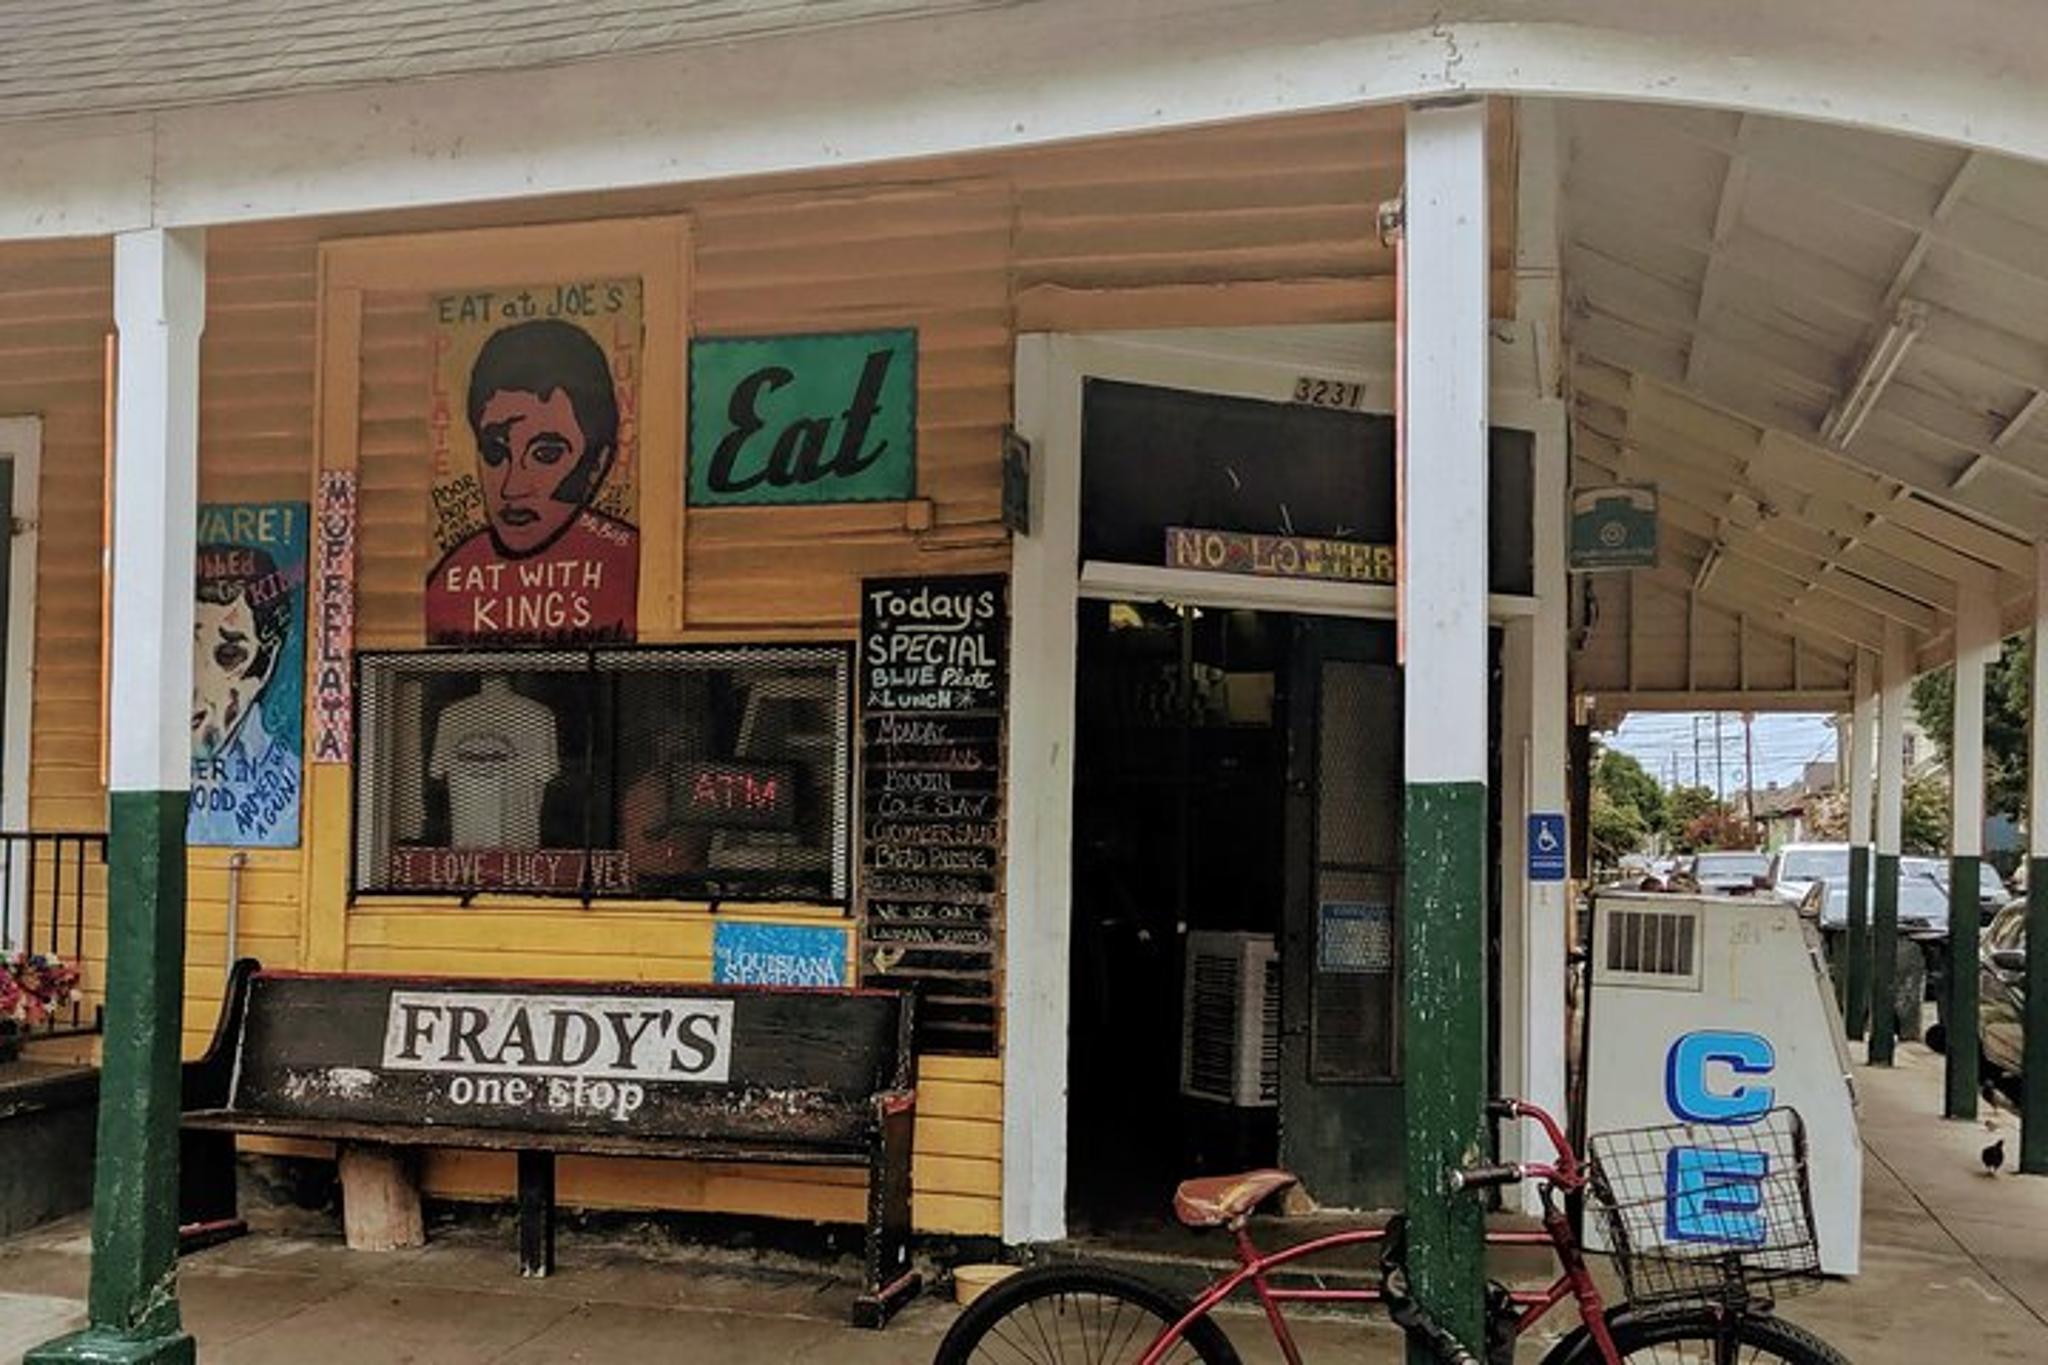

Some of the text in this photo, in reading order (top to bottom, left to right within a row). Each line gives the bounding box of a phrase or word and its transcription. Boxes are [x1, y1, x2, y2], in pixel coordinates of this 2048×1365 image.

[438, 284, 624, 323] EAT at JOE'S
[1294, 377, 1362, 408] 3231
[706, 349, 895, 493] Eat
[1176, 531, 1226, 569] NO
[446, 560, 603, 593] EAT WITH
[473, 591, 592, 631] KING'S
[867, 633, 997, 667] SPECIAL
[871, 665, 937, 689] BLUE
[693, 771, 777, 810] ATM
[431, 853, 488, 886] LOVE
[502, 853, 562, 886] LUCY
[396, 1003, 720, 1074] FRADY'S
[450, 1075, 645, 1122] one stop
